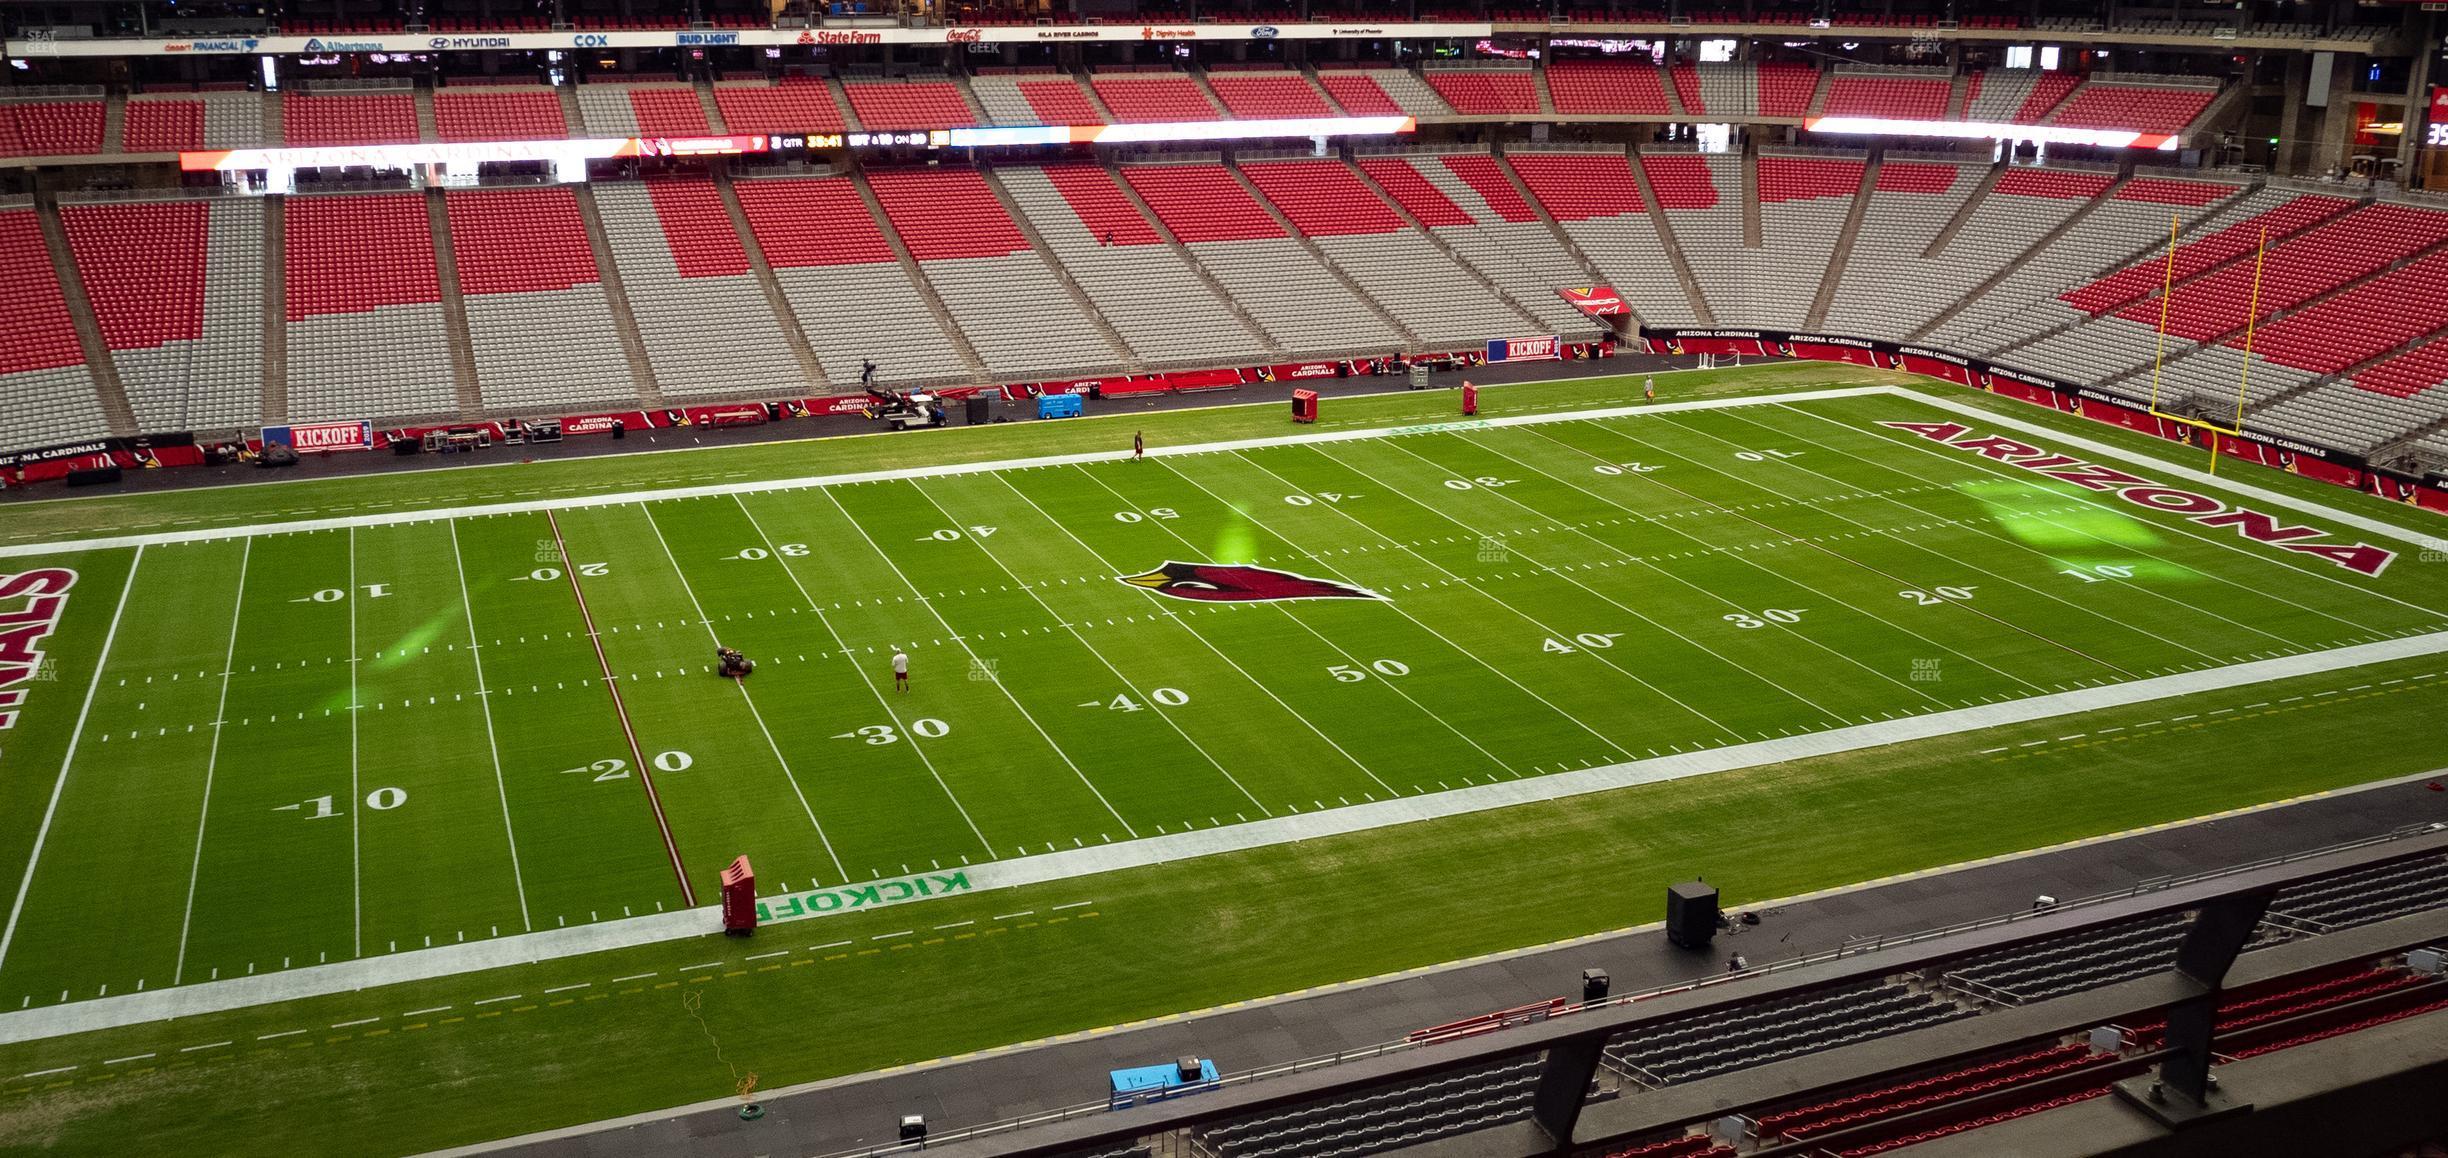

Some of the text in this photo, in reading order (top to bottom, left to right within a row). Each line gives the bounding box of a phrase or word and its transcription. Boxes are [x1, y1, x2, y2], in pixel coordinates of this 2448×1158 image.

[574, 35, 607, 46] COX
[678, 34, 736, 44] BUD LIGHT
[817, 31, 880, 43] State Farm
[1156, 30, 1176, 38] Dignity
[1256, 27, 1274, 37] Ford
[193, 42, 238, 50] FINANCIAL
[327, 42, 383, 52] Albertsons
[453, 38, 510, 47] HYUNDAI
[783, 138, 803, 148] QTR
[895, 135, 909, 144] ON
[1676, 330, 1712, 338] ARIZONA
[1789, 335, 1872, 348] ARIZONA CARDINALS
[1509, 340, 1551, 357] KICKOFF
[1900, 346, 1968, 366] ARIZONA CARDINALS
[1292, 368, 1335, 377] CARDINALS
[1988, 366, 2055, 388] ARIZONA CARDINALS
[2079, 388, 2152, 413] ARIZONA CARDINALS
[569, 422, 613, 431] CARDINA
[580, 416, 613, 424] ARIZONA
[295, 426, 359, 447] KICKOFF
[2238, 428, 2326, 458] ARIZONA CARDINALS
[42, 441, 106, 460] CARDINALS
[1873, 420, 2398, 579] ARIZONA
[2059, 564, 2134, 584] 10
[1899, 585, 1976, 606] 20
[1723, 607, 1803, 630] 30
[1542, 632, 1614, 656] 40
[1326, 659, 1410, 683] 50
[1107, 687, 1189, 713] 40
[857, 718, 950, 746] 30
[590, 750, 693, 783] 20
[304, 787, 407, 820] 10
